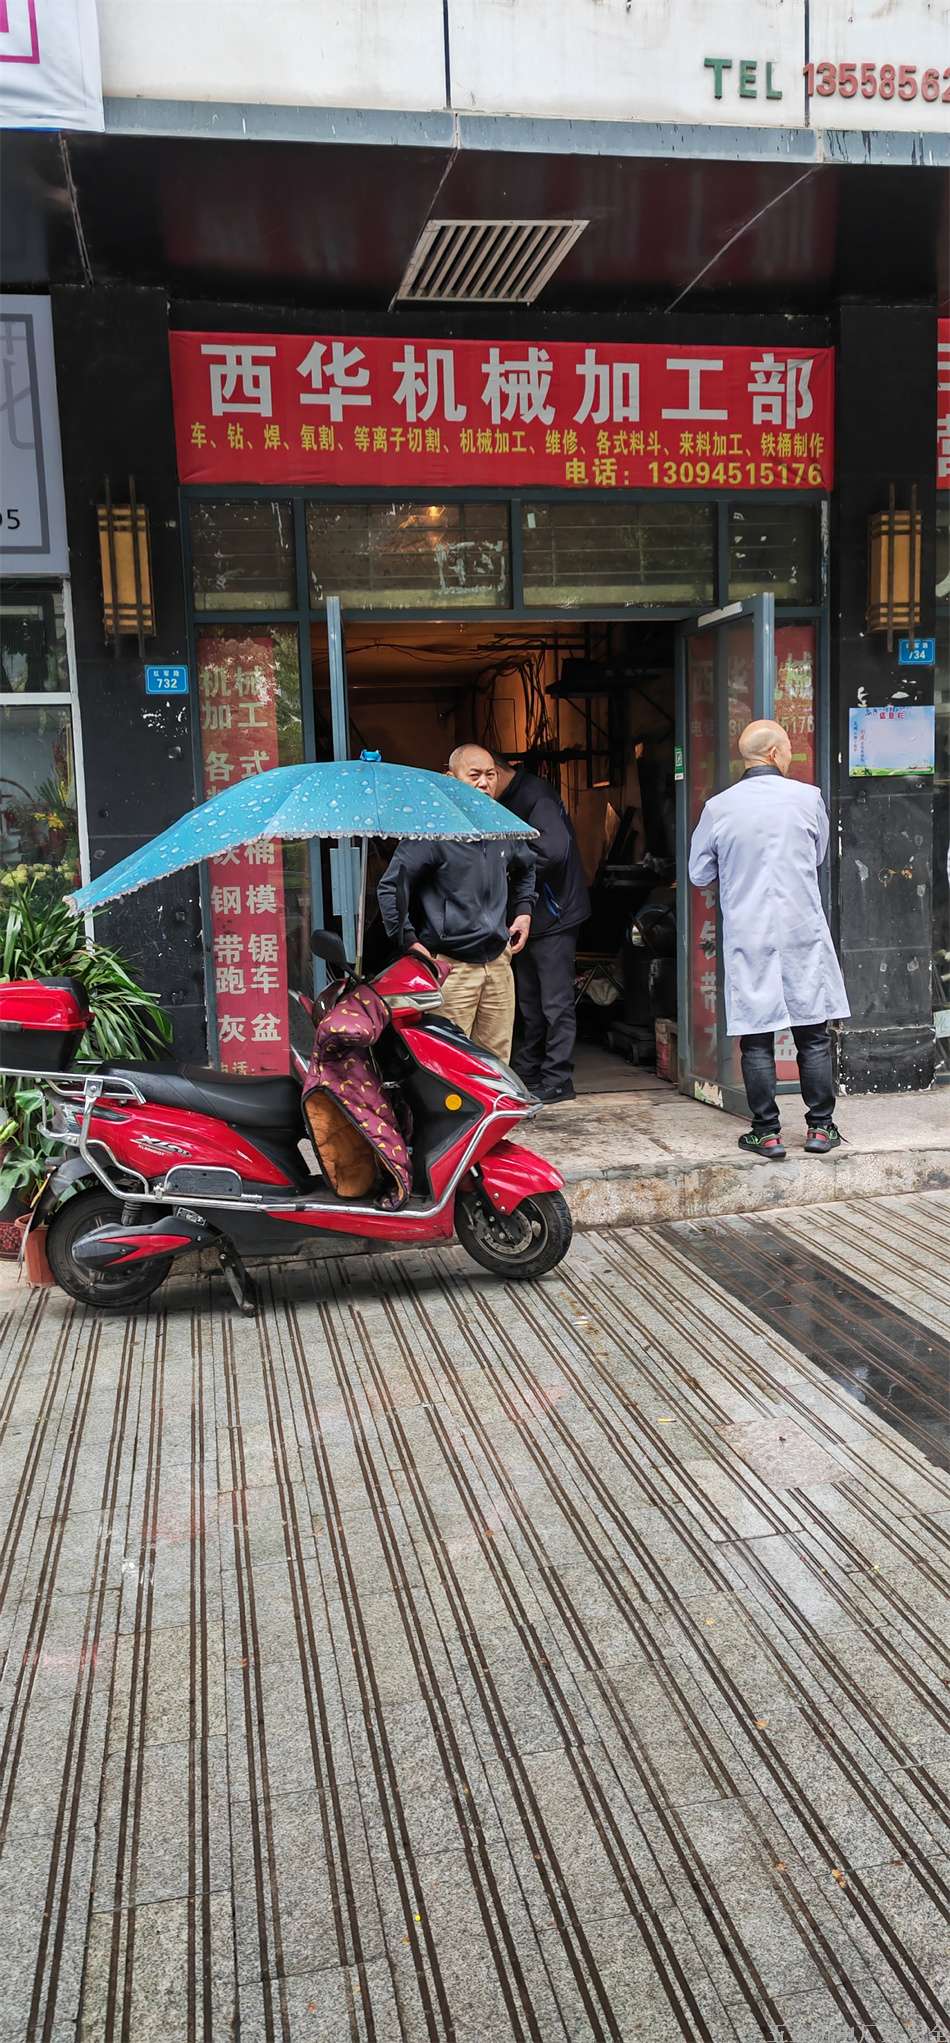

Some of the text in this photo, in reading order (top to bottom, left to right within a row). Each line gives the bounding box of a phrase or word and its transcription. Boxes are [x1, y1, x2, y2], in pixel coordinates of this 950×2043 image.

[704, 57, 783, 100] TEL
[200, 341, 815, 430] 西华机械加工部
[156, 678, 178, 689] 732
[202, 701, 269, 731] 加工
[211, 885, 277, 915] 钢模
[213, 933, 280, 965] 带锯
[214, 965, 280, 994] 跑车
[217, 1013, 282, 1043] 灰盆
